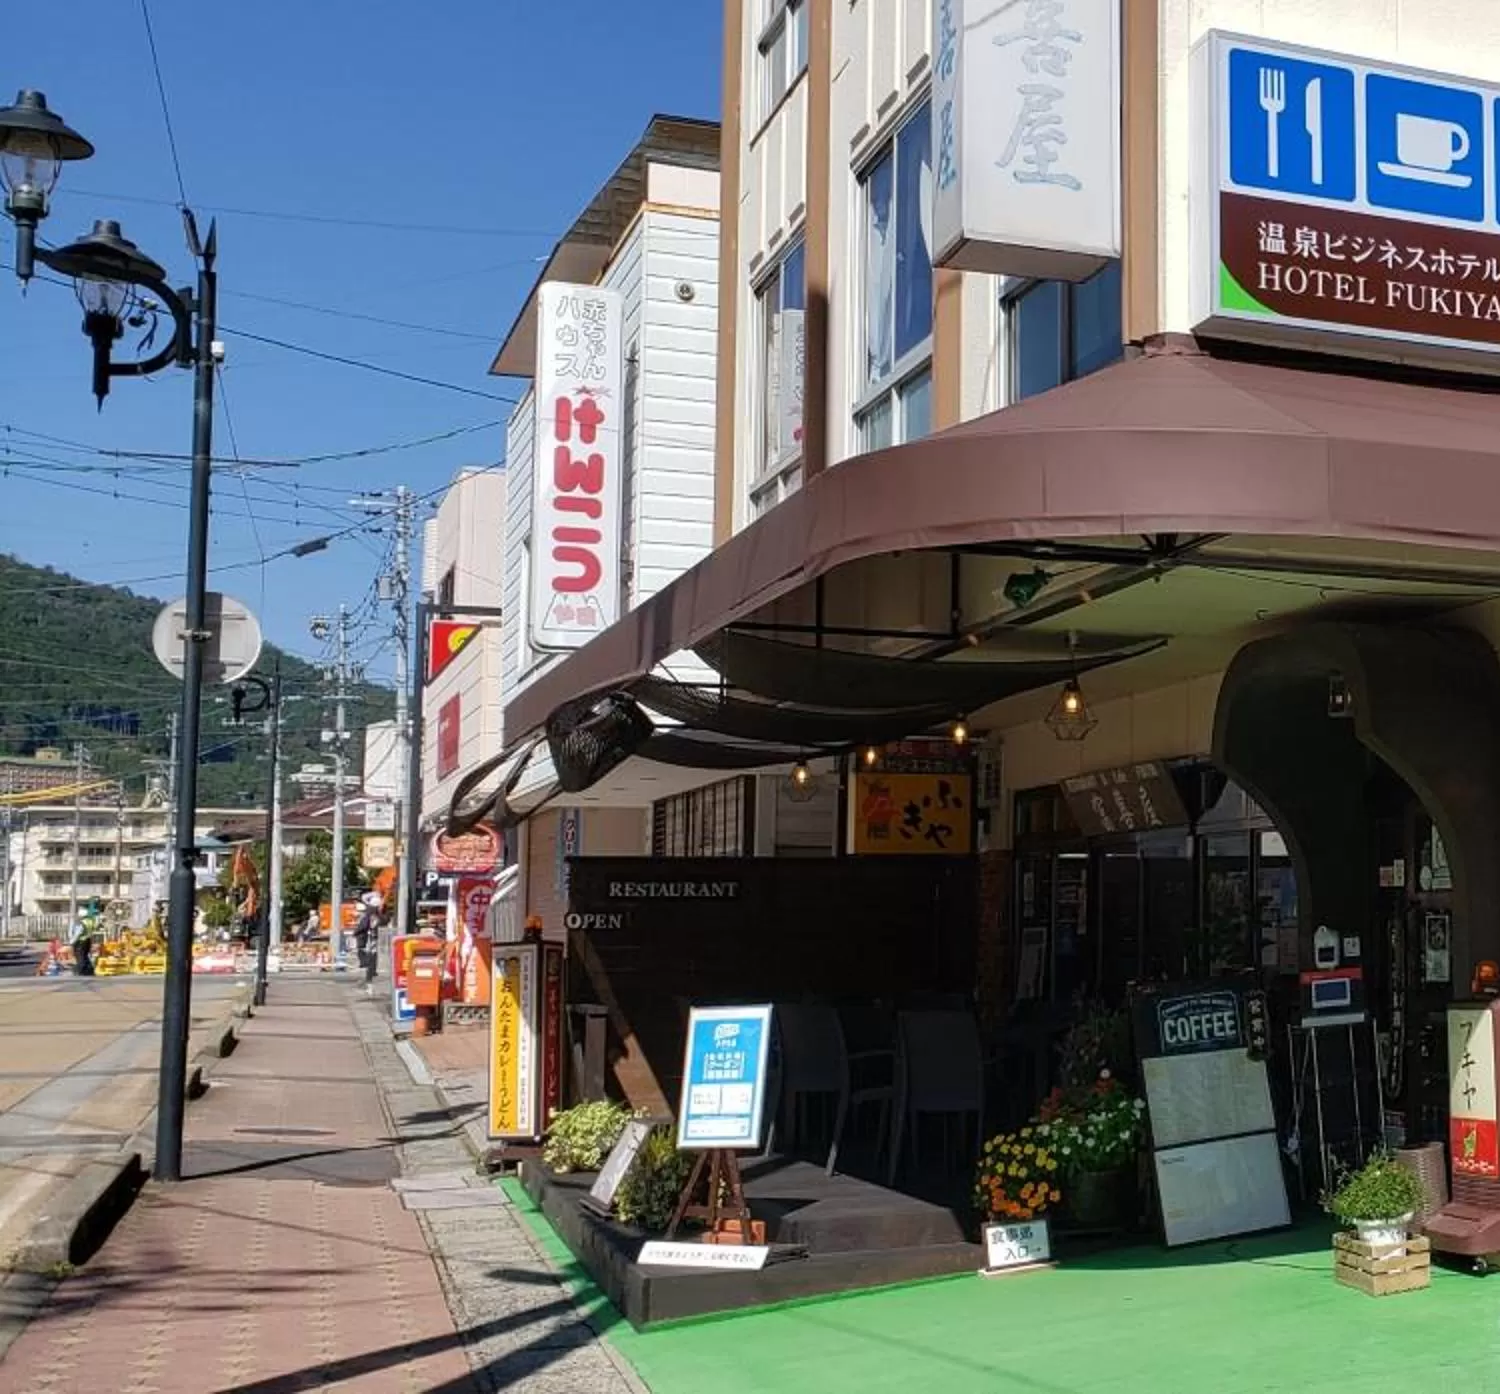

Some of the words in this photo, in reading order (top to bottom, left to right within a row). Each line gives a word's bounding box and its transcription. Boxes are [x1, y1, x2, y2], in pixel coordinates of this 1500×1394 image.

[1257, 262, 1376, 306] HOTEL
[555, 295, 581, 379] ハウス
[582, 298, 607, 380] 赤ちゃん
[608, 880, 740, 898] RESTAURANT
[566, 912, 624, 929] OPEN
[1163, 1010, 1237, 1044] COFFEE
[1004, 1244, 1029, 1261] 入口
